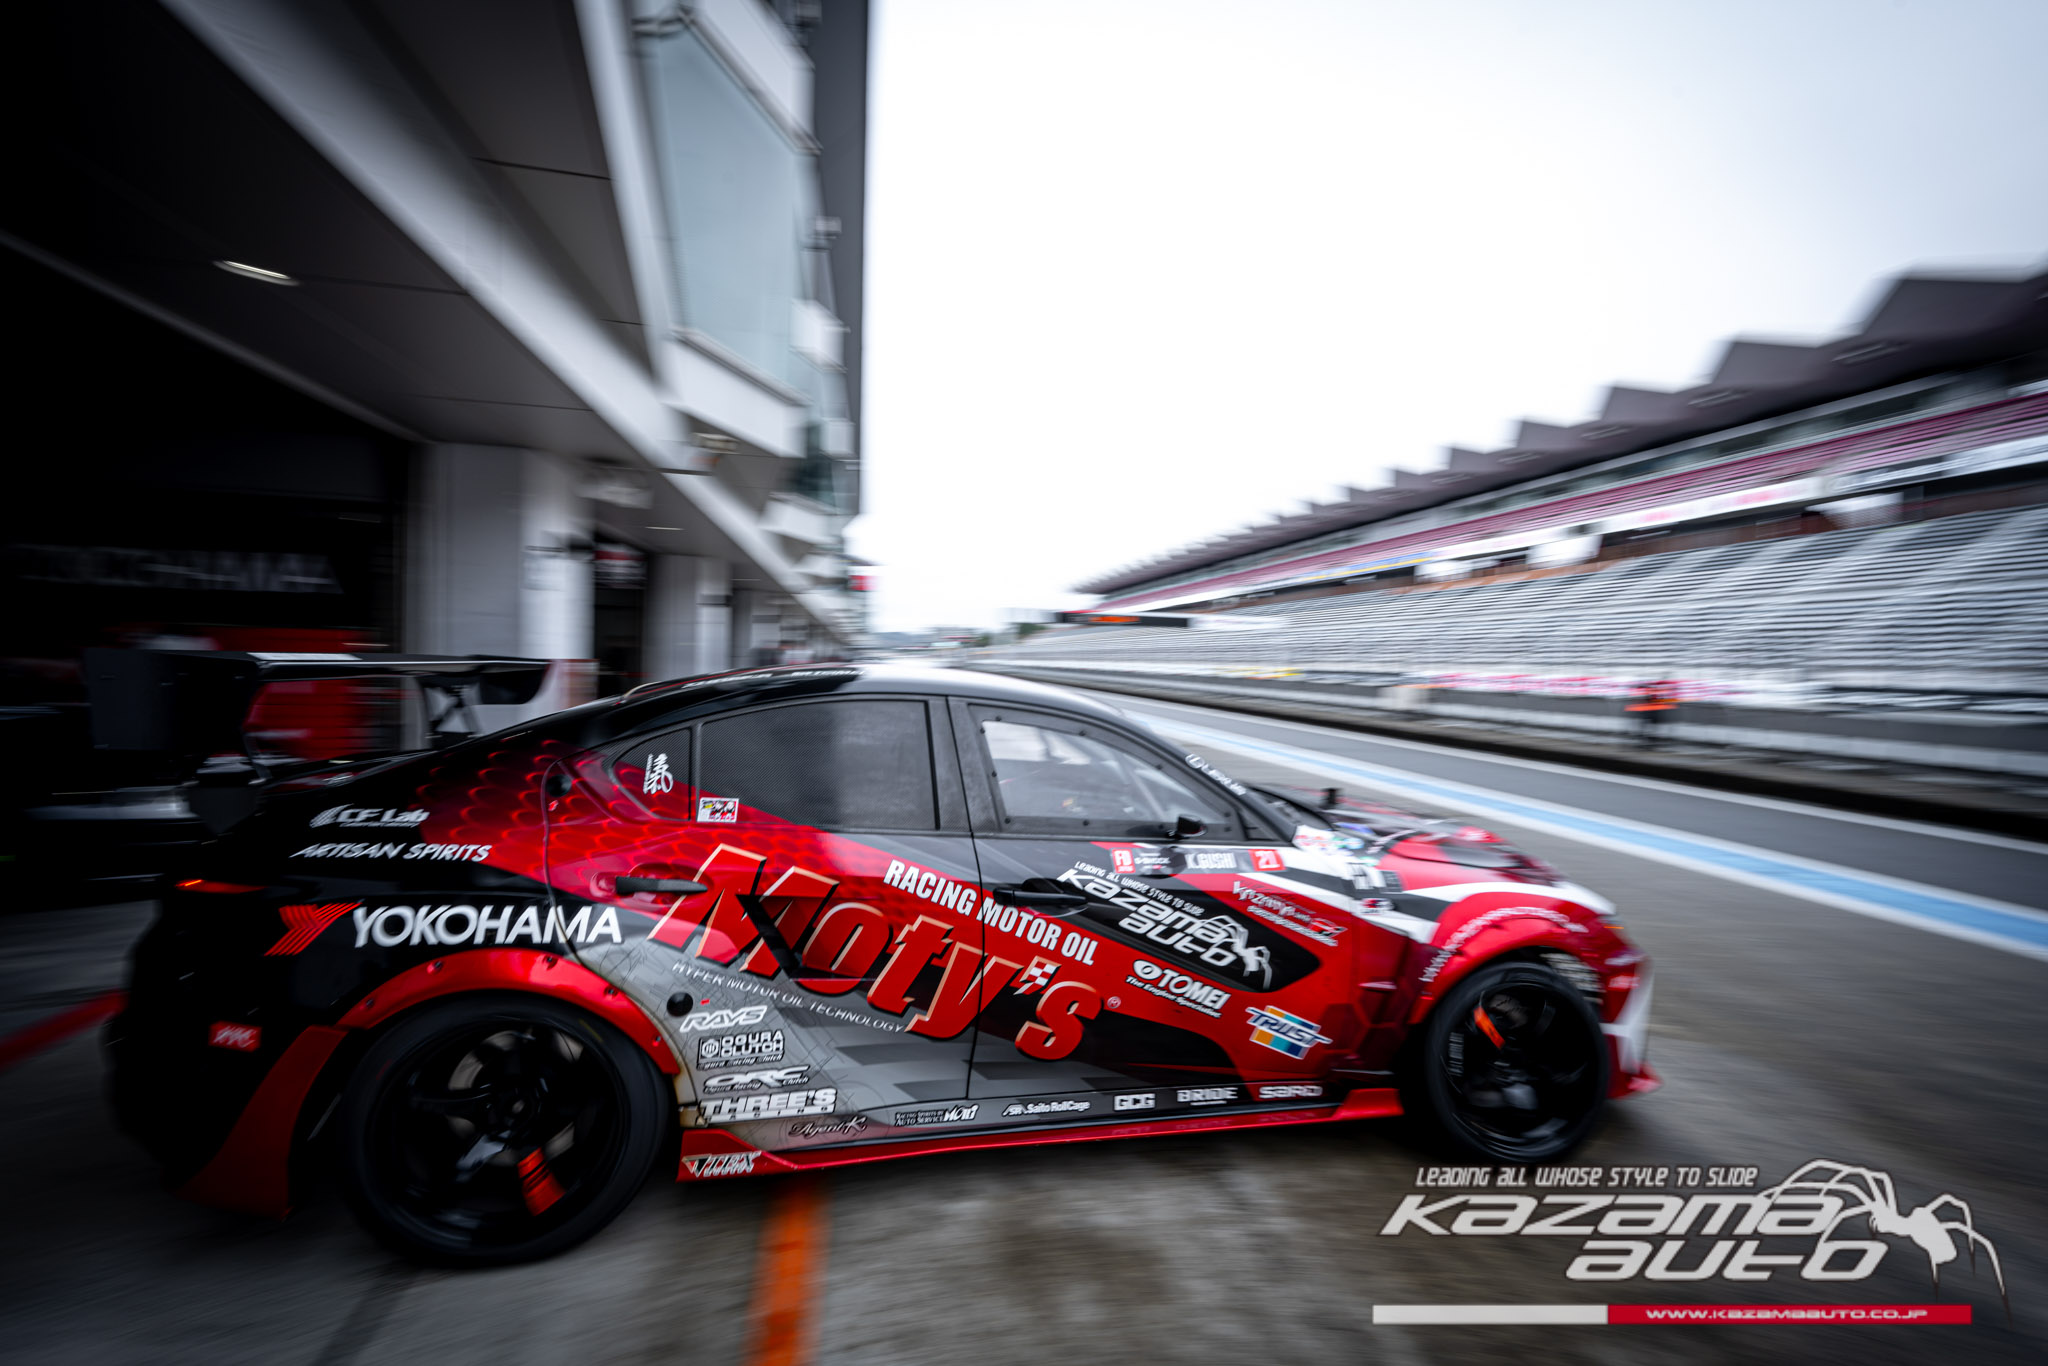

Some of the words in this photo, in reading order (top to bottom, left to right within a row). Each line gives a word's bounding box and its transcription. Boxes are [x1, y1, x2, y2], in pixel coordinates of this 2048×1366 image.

[289, 842, 406, 859] ARTISAN
[403, 844, 492, 862] SPIRITS
[1255, 850, 1281, 870] 21
[353, 904, 622, 948] YOKOHAMA
[883, 858, 977, 917] RACING
[976, 896, 1062, 951] MOTOR
[1060, 931, 1099, 966] OIL
[647, 842, 1103, 1061] Moty's
[672, 961, 724, 986] HYPER
[726, 978, 781, 1001] MOTOR
[781, 989, 805, 1009] OIL
[809, 1000, 905, 1034] TECHNOLOGY
[1157, 967, 1232, 1010] TOMEI
[680, 1005, 768, 1033] RAYS
[1246, 1007, 1333, 1046] TRUST
[721, 1030, 784, 1048] OGURA
[721, 1040, 784, 1058] CLUTCH
[704, 1065, 811, 1089] ORC
[700, 1088, 836, 1118] THREE'S
[1114, 1093, 1155, 1111] GCG
[1177, 1087, 1239, 1102] BRIDE
